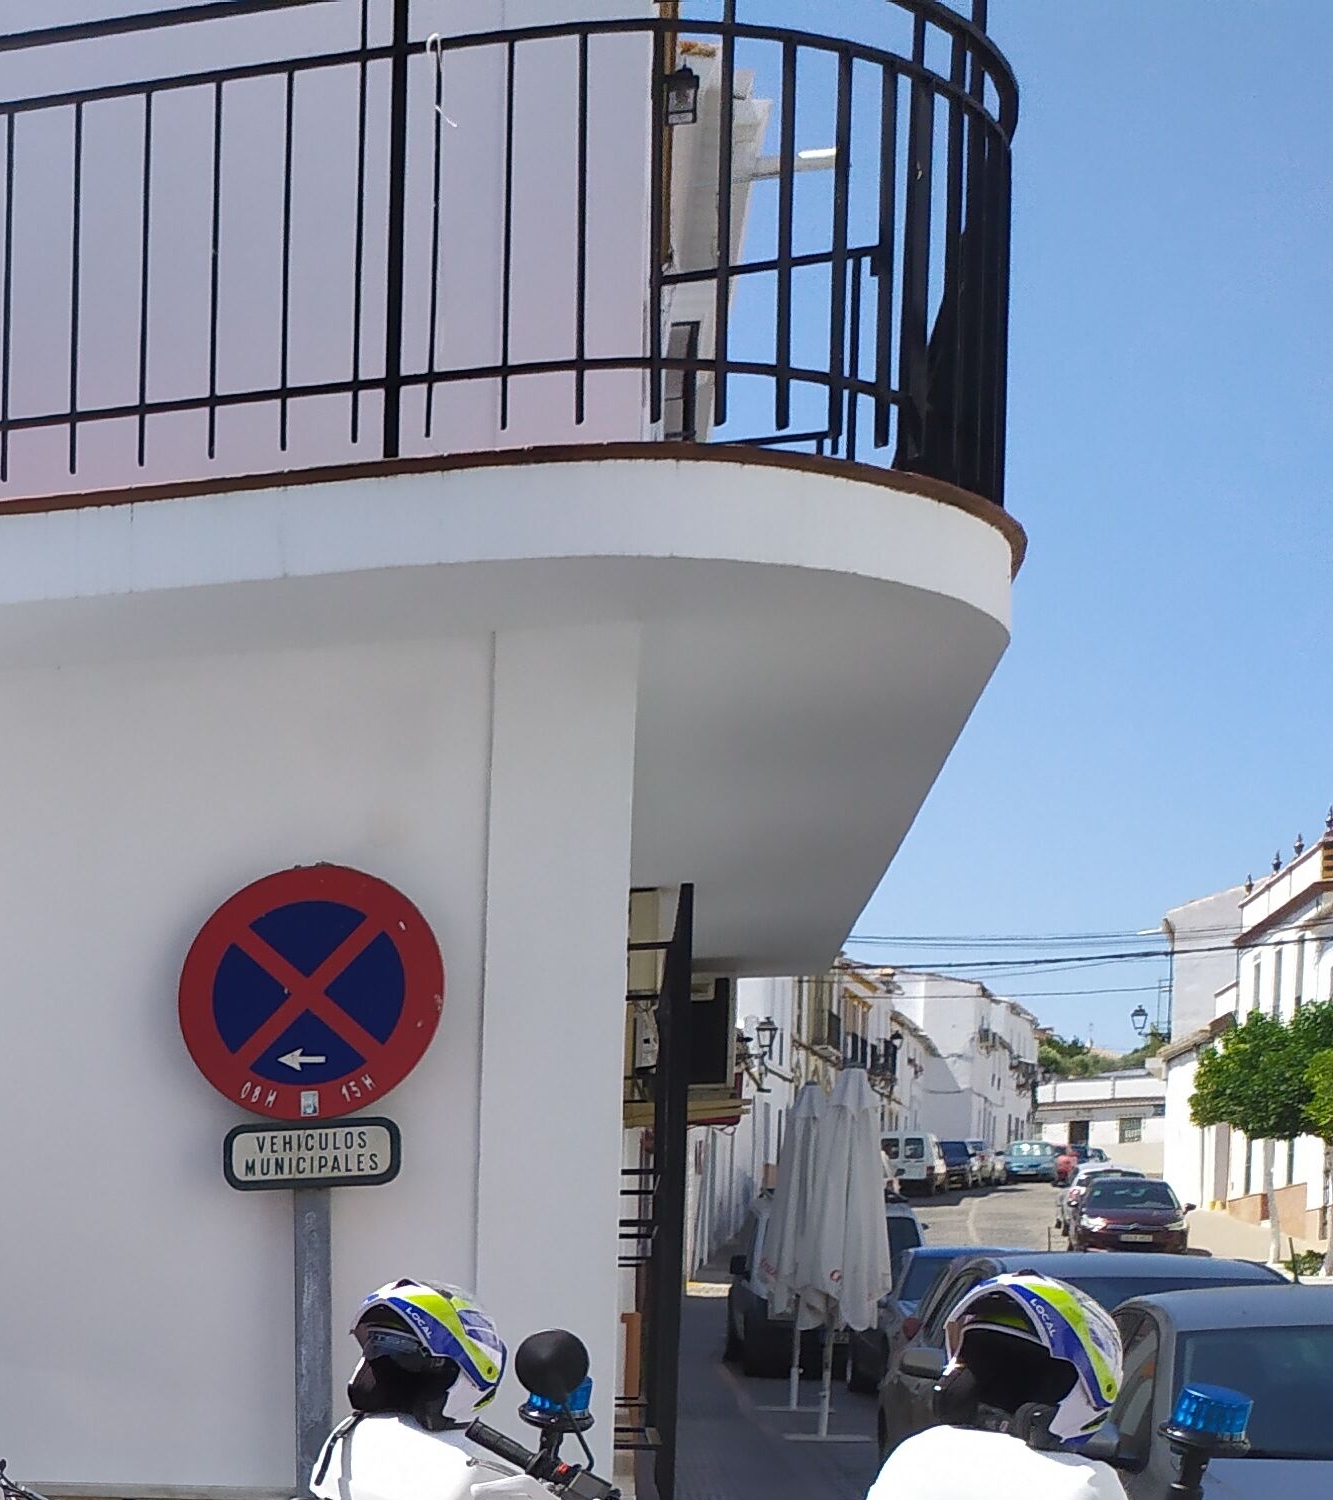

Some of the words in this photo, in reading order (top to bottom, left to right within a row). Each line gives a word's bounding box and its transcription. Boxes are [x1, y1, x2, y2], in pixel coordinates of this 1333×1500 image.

[255, 1131, 368, 1154] VEHICULOS
[244, 1153, 379, 1177] MUNICIPALES
[405, 1306, 433, 1340] LOCAL
[1029, 1298, 1056, 1338] LOCAL
